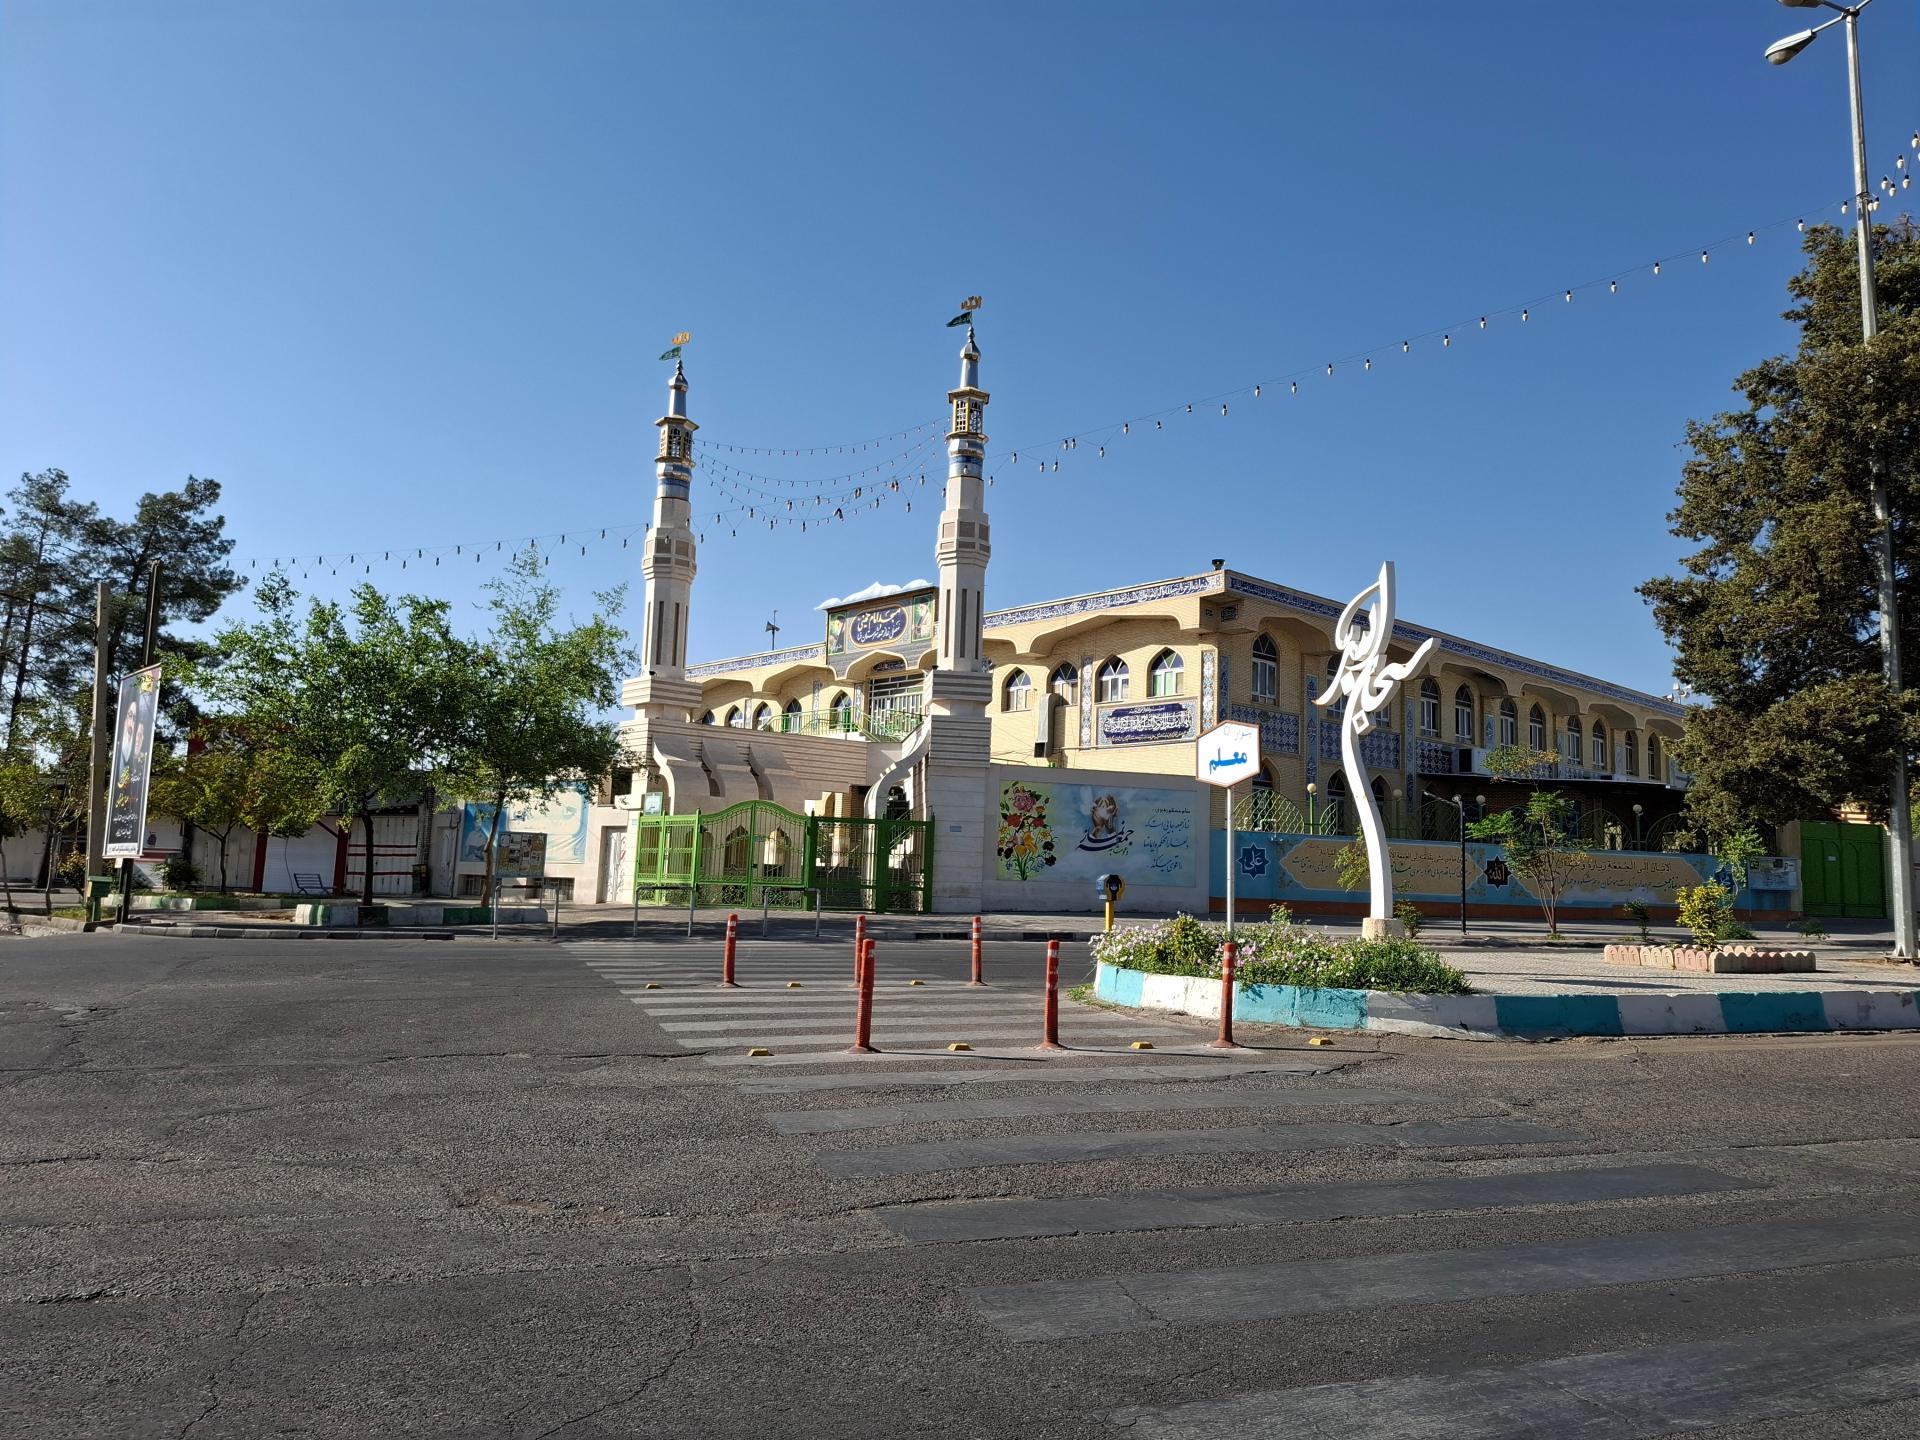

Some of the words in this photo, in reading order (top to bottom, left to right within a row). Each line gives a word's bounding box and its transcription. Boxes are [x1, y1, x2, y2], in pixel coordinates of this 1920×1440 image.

[879, 608, 902, 624] مسجد
[1209, 746, 1248, 776] معلم
[1075, 829, 1135, 852] جمعه
[1079, 819, 1126, 845] نماز
[1488, 863, 1504, 881] الله
